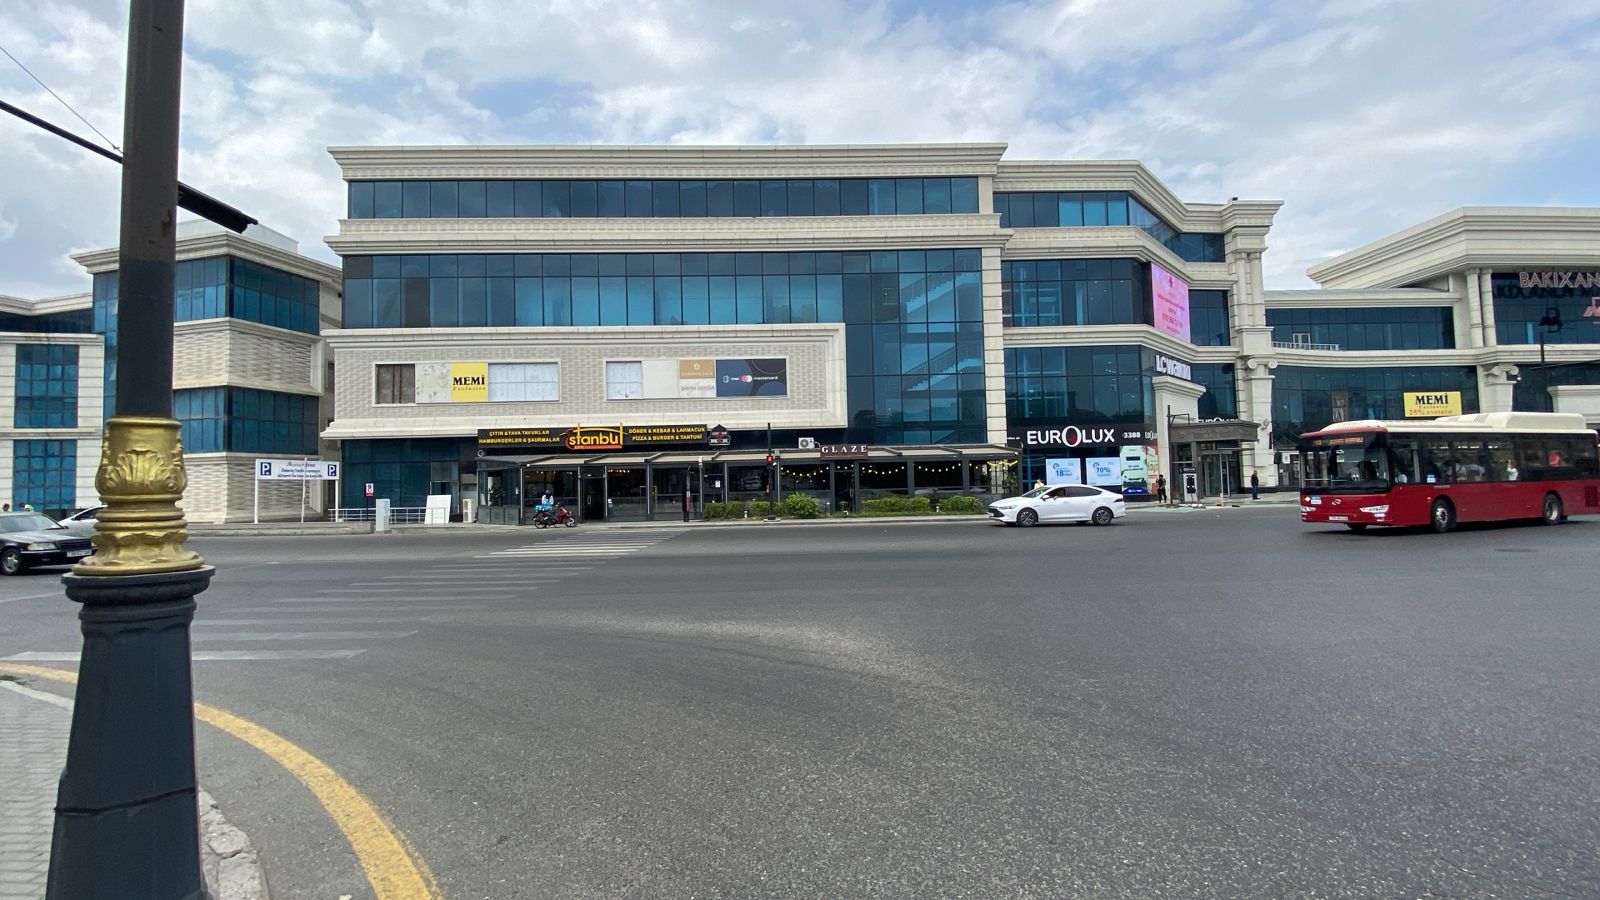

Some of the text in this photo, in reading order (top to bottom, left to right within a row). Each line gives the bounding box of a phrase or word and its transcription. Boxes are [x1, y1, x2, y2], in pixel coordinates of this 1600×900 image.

[453, 375, 485, 386] MEMİ
[1415, 393, 1449, 405] MEMİ
[1026, 425, 1115, 447] EUROLUX
[821, 445, 867, 453] GLAZE
[1056, 469, 1064, 477] 18
